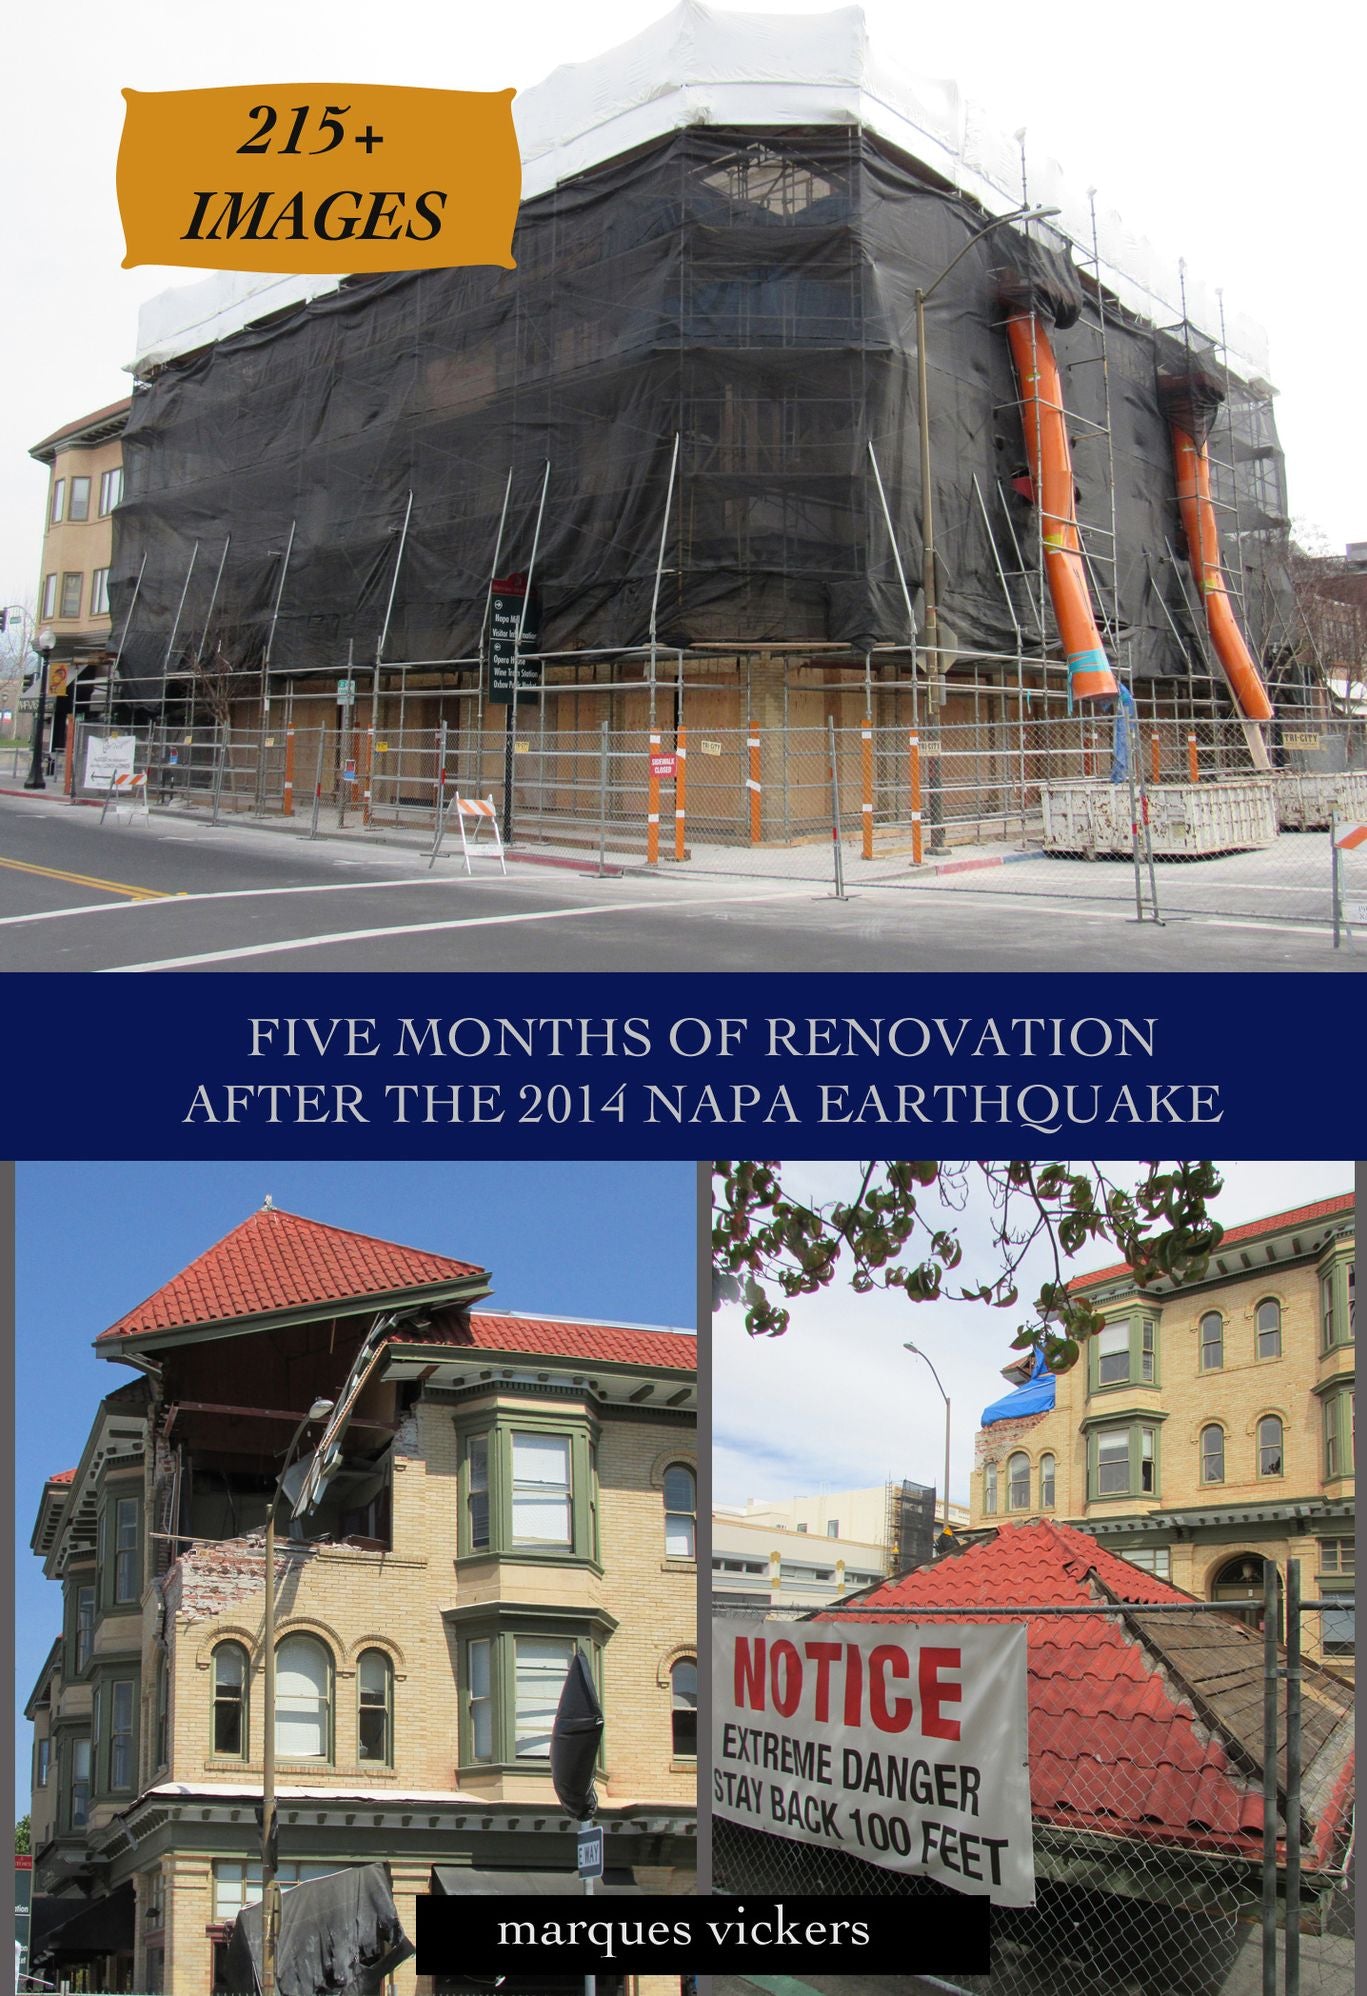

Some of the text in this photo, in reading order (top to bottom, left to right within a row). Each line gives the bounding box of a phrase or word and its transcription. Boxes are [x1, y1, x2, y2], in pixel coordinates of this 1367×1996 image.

[495, 613, 510, 624] Napa
[492, 628, 537, 640] Visitor Inmation
[493, 654, 526, 666] Opera Huse
[493, 667, 538, 678] Wine Tran Station
[493, 679, 508, 689] Oxbow
[508, 680, 521, 689] Puic
[734, 1636, 962, 1742] NOTICE
[722, 1722, 981, 1817] EXTREME DANGER
[713, 1767, 1009, 1887] STAY BACK 100 FEET
[584, 1842, 600, 1865] WAY
